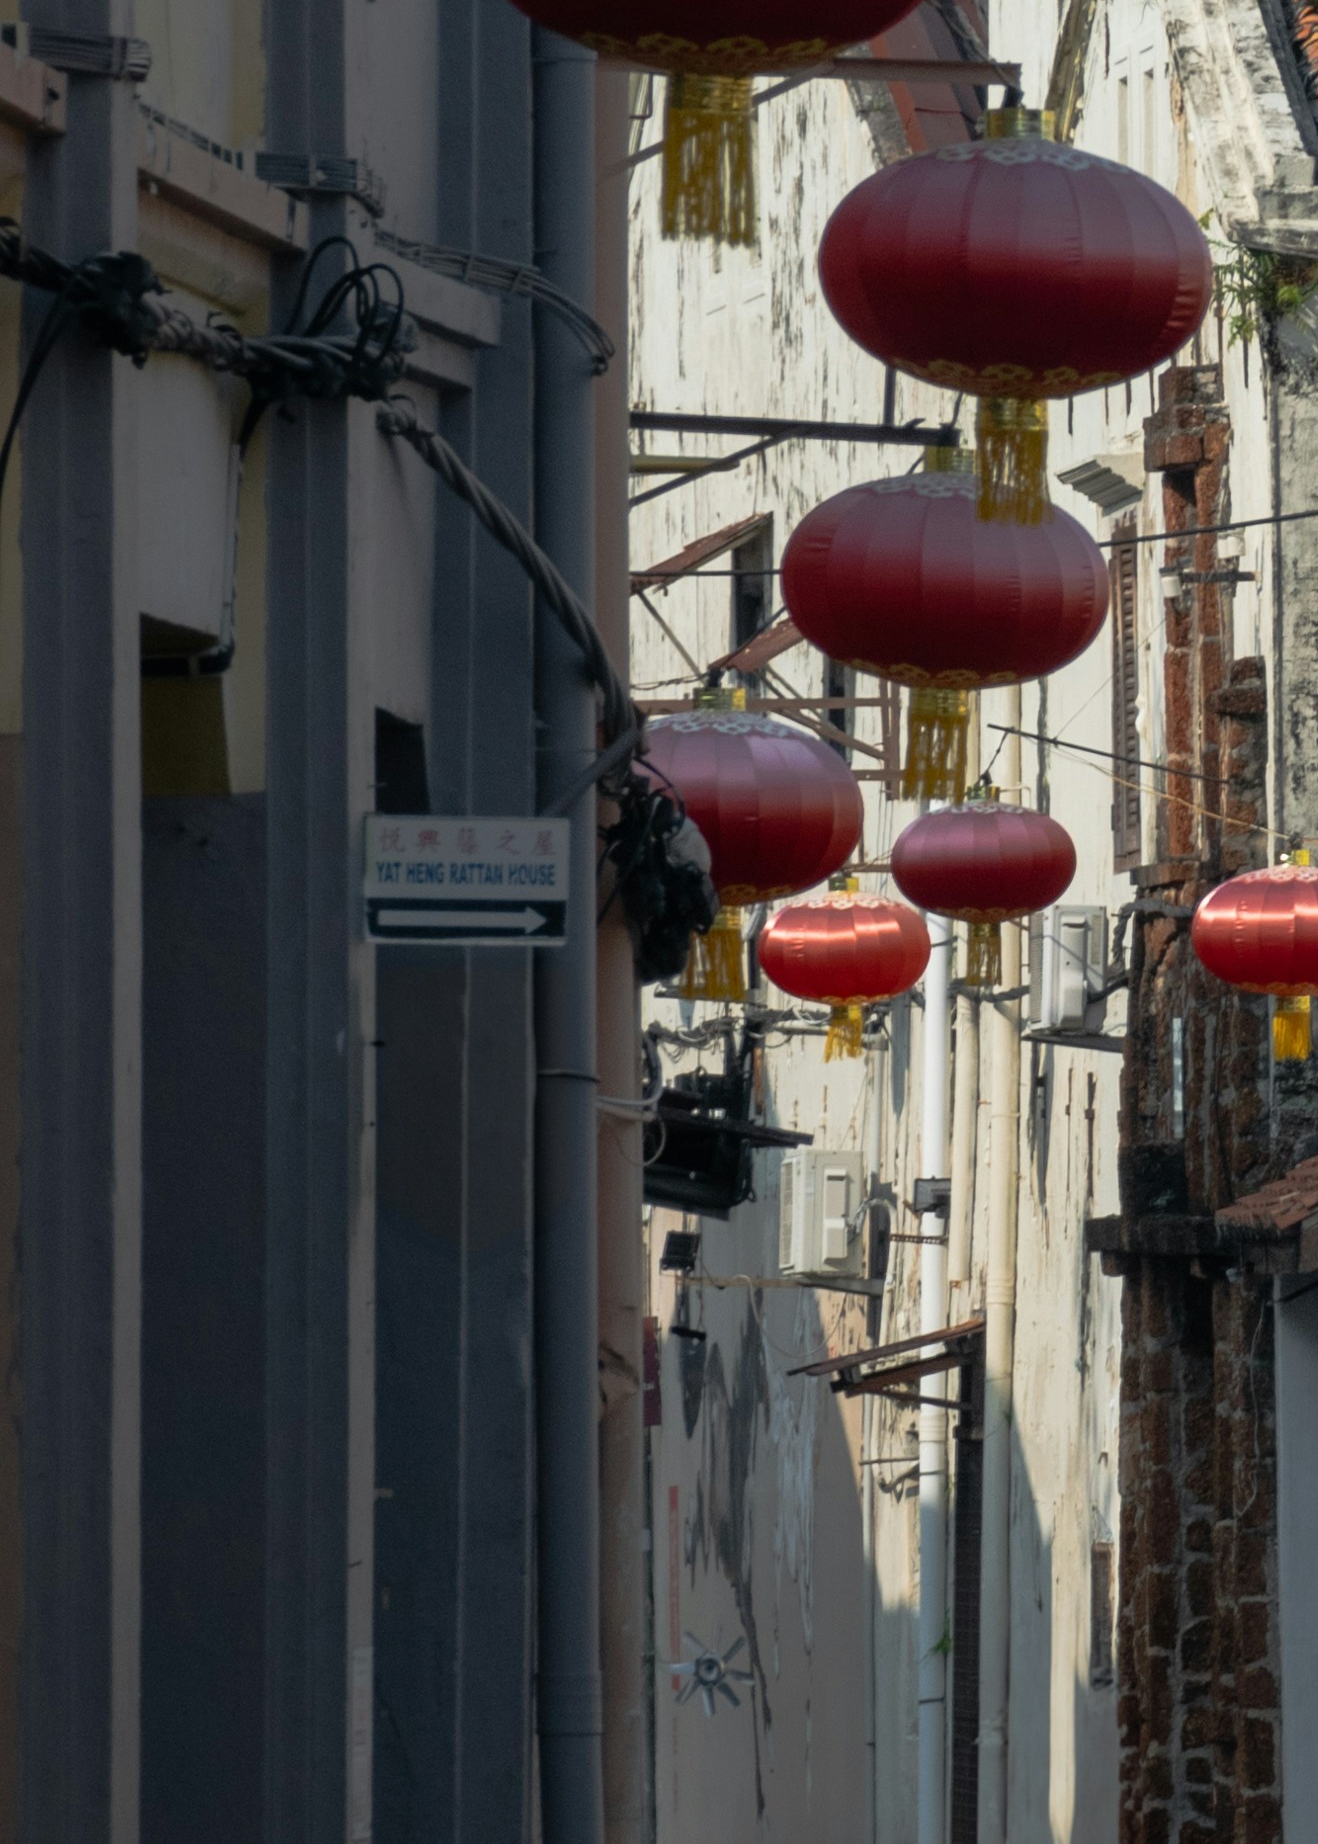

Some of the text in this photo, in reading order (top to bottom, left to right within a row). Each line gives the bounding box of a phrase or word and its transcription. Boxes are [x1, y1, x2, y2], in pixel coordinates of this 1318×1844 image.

[376, 862, 555, 887] YAT HENG RATTAN HOUSE
